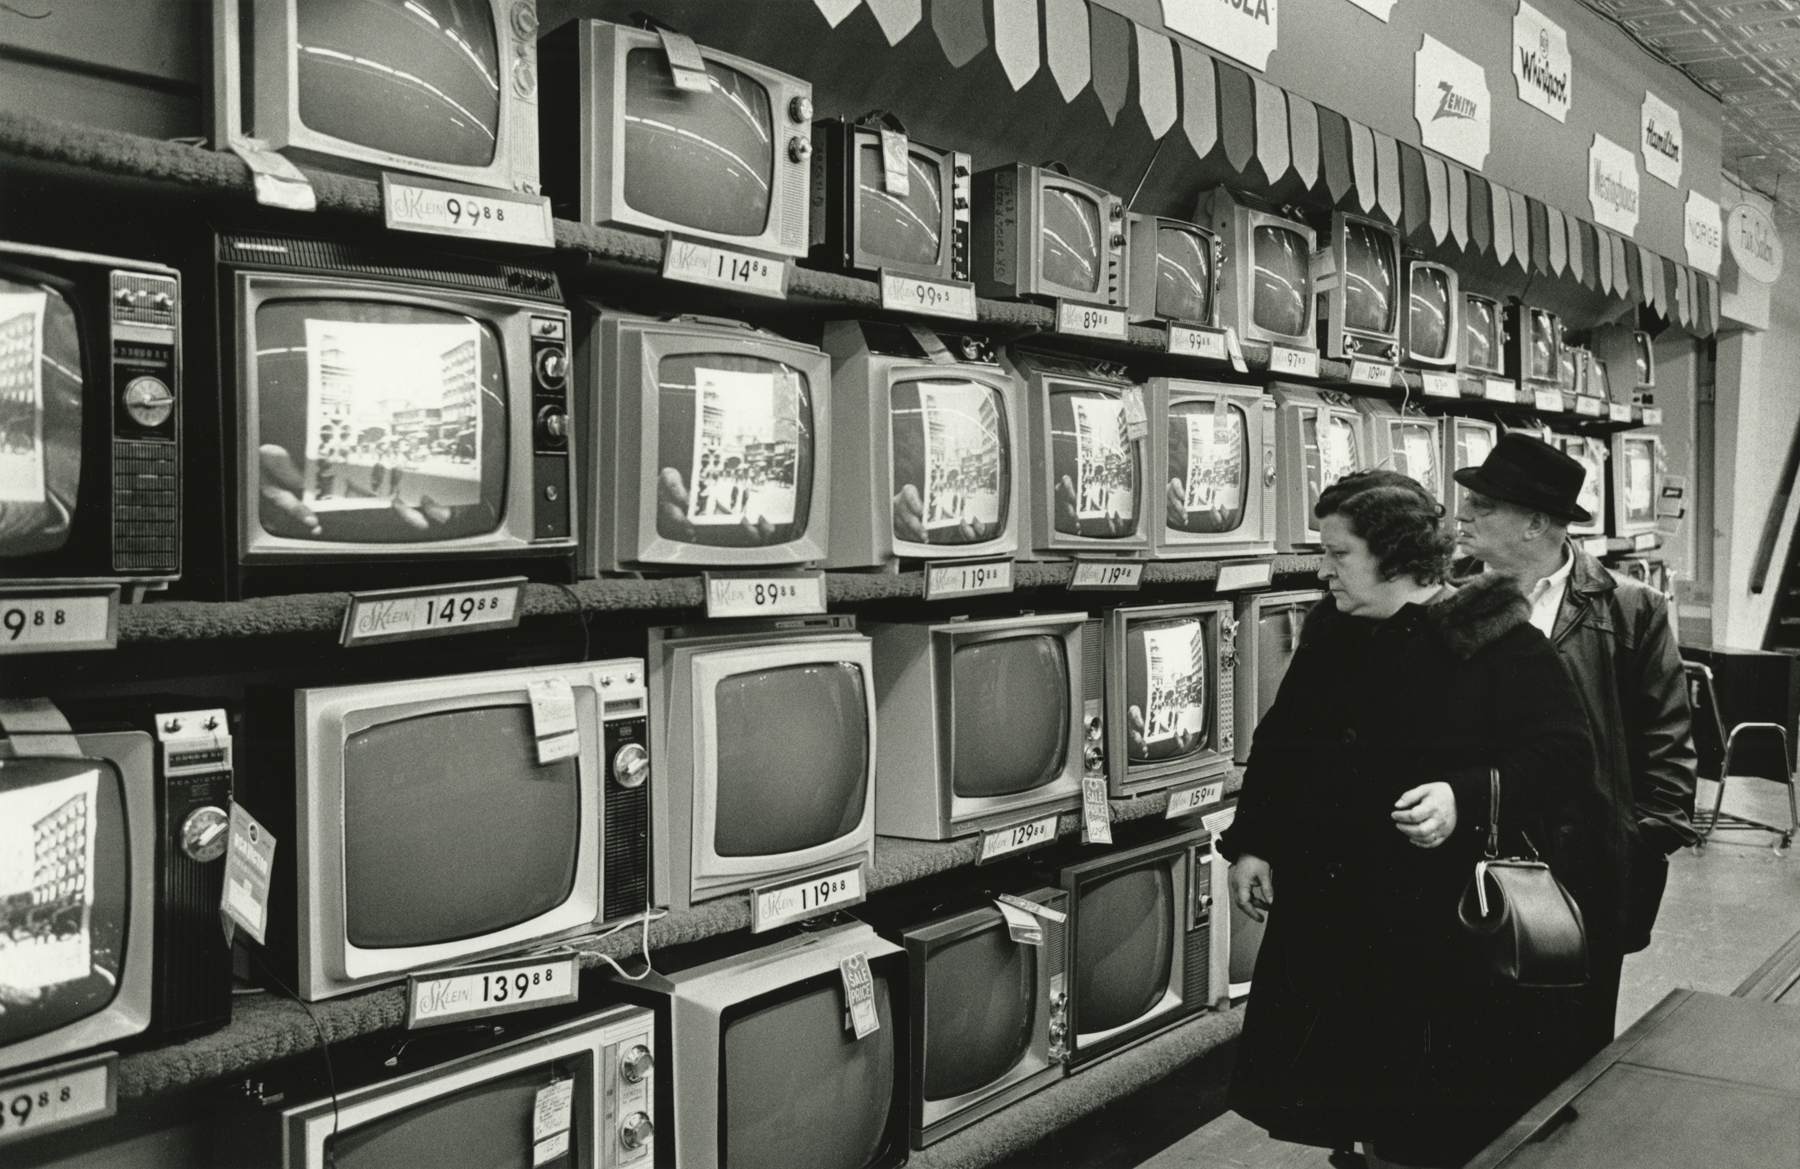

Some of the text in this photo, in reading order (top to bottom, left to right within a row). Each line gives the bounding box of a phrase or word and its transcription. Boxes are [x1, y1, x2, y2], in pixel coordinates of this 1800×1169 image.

[1431, 80, 1478, 122] ZENITH
[1689, 218, 1719, 249] NORGE
[1086, 791, 1104, 804] SALE
[847, 967, 869, 988] SALE
[850, 983, 872, 1005] PRICE
[0, 1086, 71, 1127] 988
